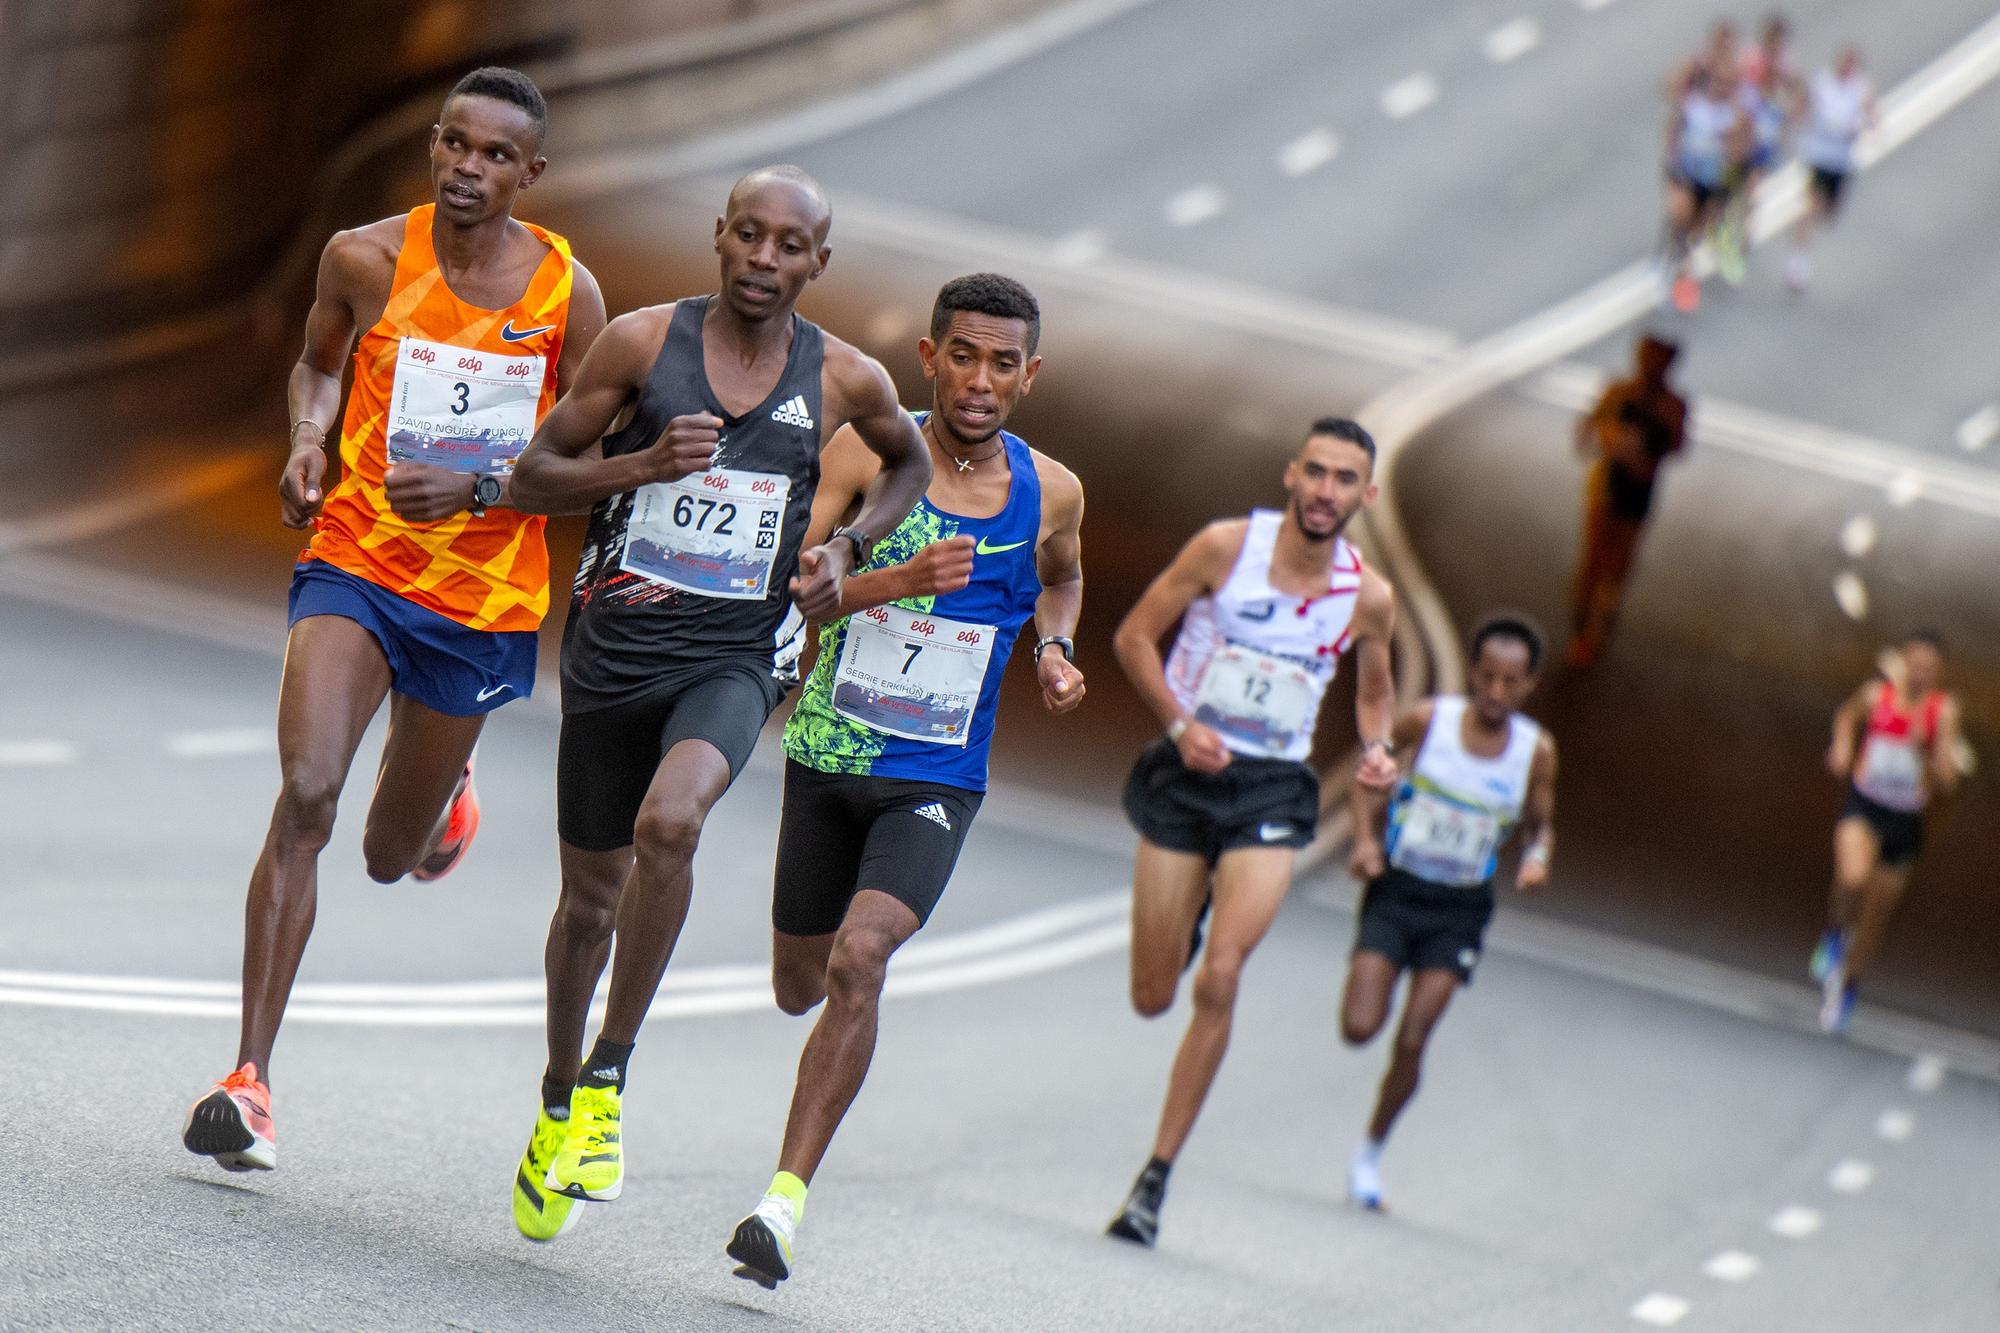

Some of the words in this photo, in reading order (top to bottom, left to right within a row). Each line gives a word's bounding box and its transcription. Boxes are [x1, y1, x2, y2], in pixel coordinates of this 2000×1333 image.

[411, 347, 435, 365] edp
[457, 356, 482, 374] edp
[505, 362, 530, 379] edp
[450, 382, 470, 415] 3
[397, 416, 432, 431] DAVID
[435, 423, 478, 437] NGURE
[480, 428, 524, 437] IRUNGU
[771, 410, 814, 430] adidas
[703, 474, 730, 492] edp
[751, 479, 776, 496] edp
[673, 494, 738, 537] 672
[865, 607, 889, 625] edp
[910, 619, 936, 637] edp
[956, 629, 981, 646] edp
[901, 643, 923, 675] 7
[845, 667, 879, 685] GEBRIE
[880, 680, 924, 698] ERKIHUN
[1244, 676, 1271, 706] 12
[914, 809, 951, 831] adidas
